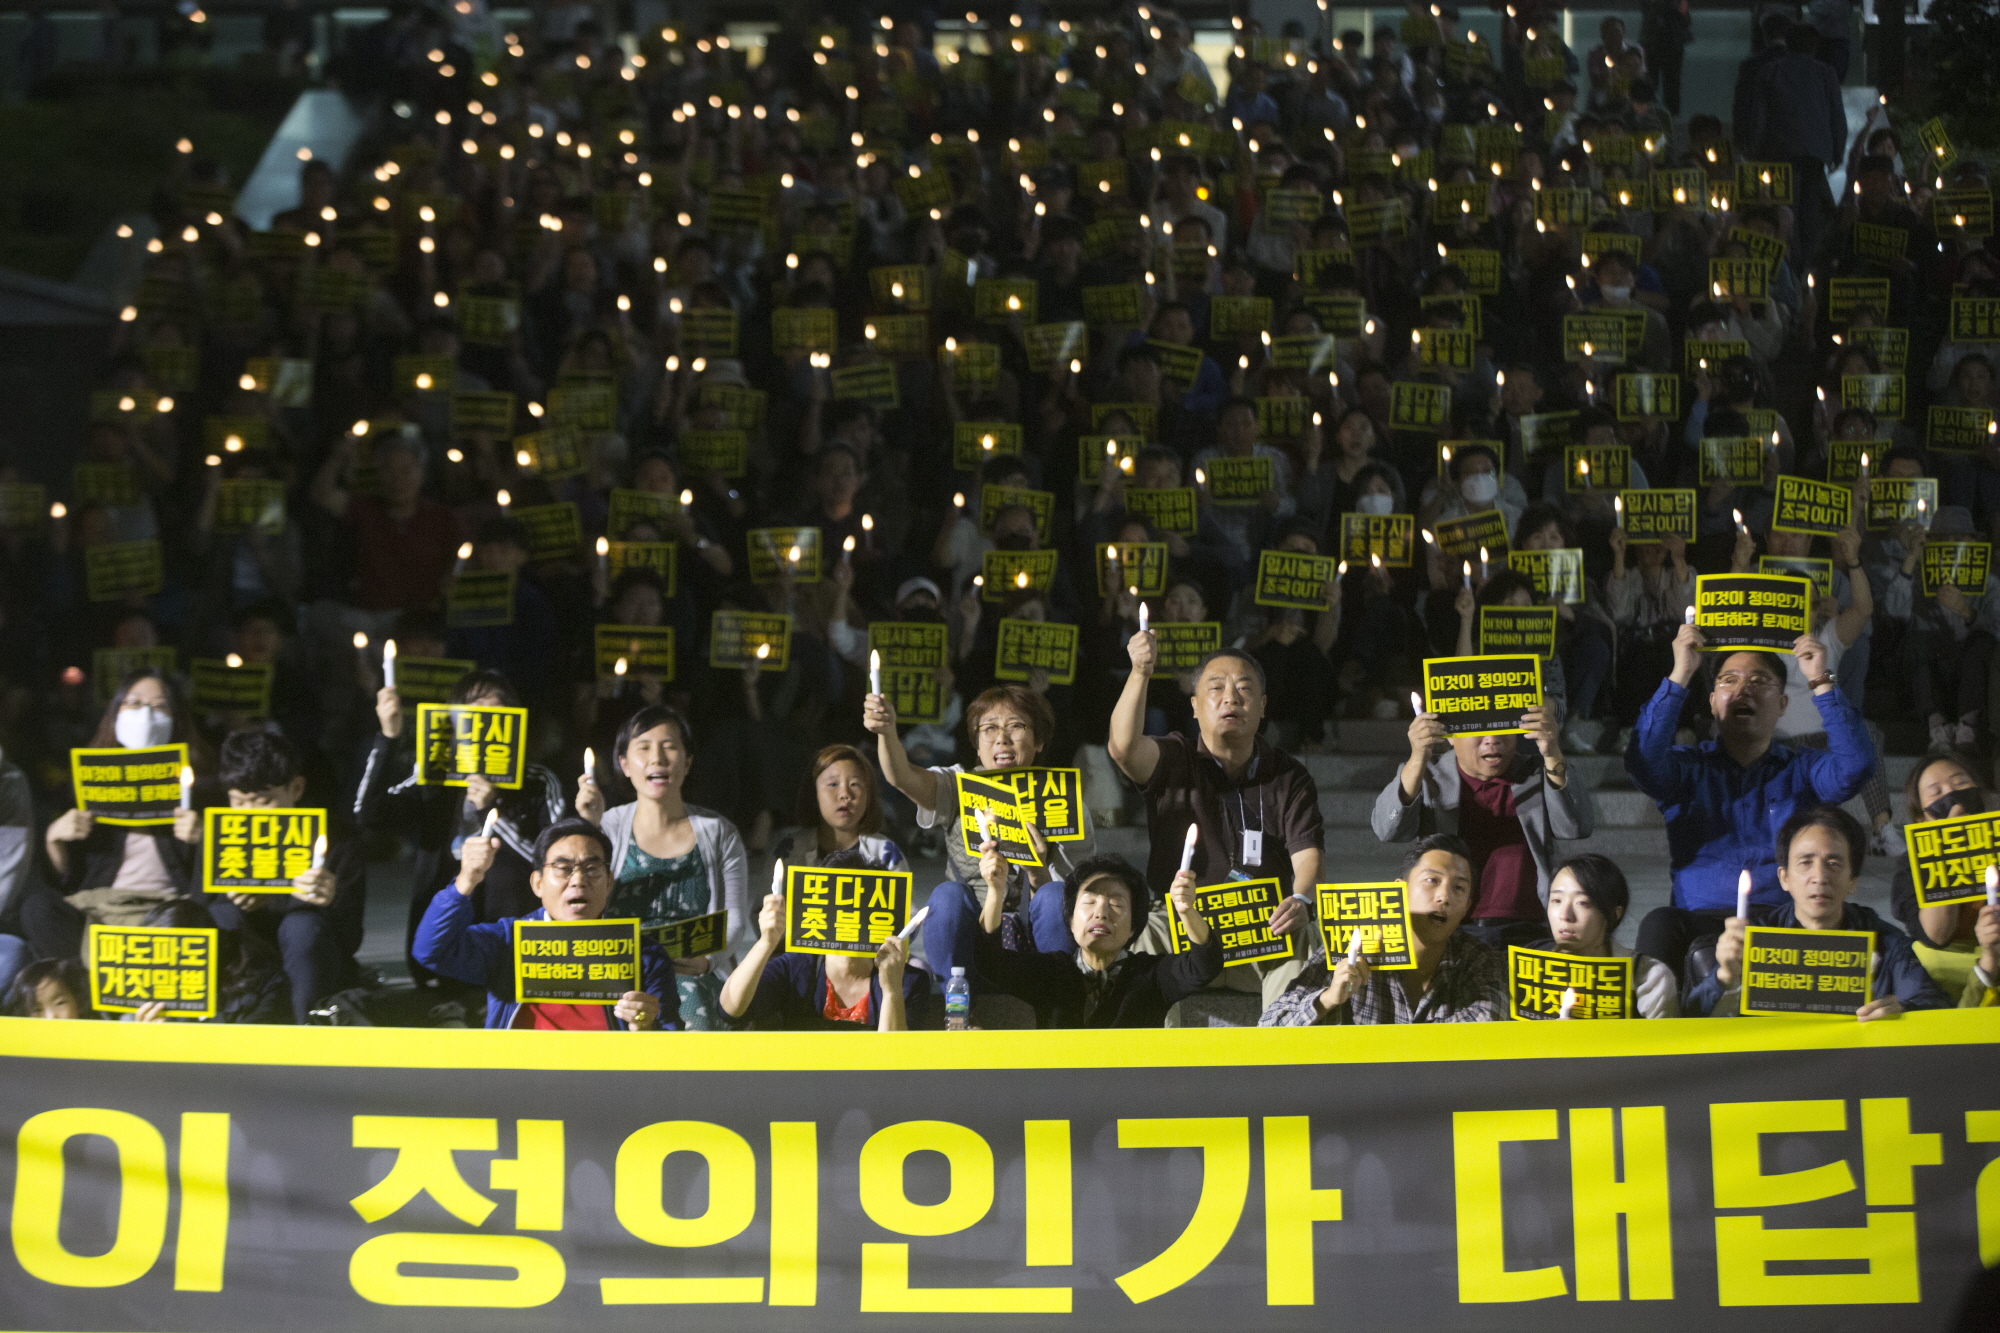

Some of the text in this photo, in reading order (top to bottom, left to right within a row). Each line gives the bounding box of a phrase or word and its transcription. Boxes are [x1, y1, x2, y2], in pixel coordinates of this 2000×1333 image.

[1626, 493, 1691, 513] 입시농단
[1783, 481, 1847, 510] 입시농단
[1627, 515, 1690, 532] 조국OUT!
[1780, 502, 1845, 526] 조국OUT!
[1265, 556, 1330, 581] 입시농단
[1263, 576, 1323, 599] 조국OUT
[1701, 590, 1805, 610] 이것이 정의인가
[1700, 611, 1805, 631] 대답하라 문재인
[1430, 672, 1537, 692] 이것이 정의인가
[1431, 693, 1537, 713] 대답하라 문재인
[429, 711, 514, 744] 또다시
[1462, 722, 1483, 731] STOP!
[429, 741, 512, 775] 촛불을
[961, 791, 988, 811] 이것이
[218, 814, 313, 847] 또다시
[218, 845, 312, 880] 촛불을
[1920, 851, 2000, 889] 거짓말
[801, 874, 898, 911] 또다시
[1207, 887, 1269, 910] 모릅니다
[1322, 891, 1402, 921] 파도파도
[800, 907, 897, 944] 촛불을
[98, 934, 207, 966] 파도파도
[521, 938, 635, 957] 이것이 정의인가
[821, 941, 843, 950] STOP!
[1750, 946, 1867, 969] 이것이 정의인가
[522, 961, 635, 980] 대답하라 문재인
[1517, 954, 1622, 992] 파도파도
[99, 966, 207, 1000] 거짓말뿐
[1749, 971, 1866, 994] 대답하라 문재인
[11, 1107, 231, 1292] 이
[349, 1114, 1342, 1313] 정의인가
